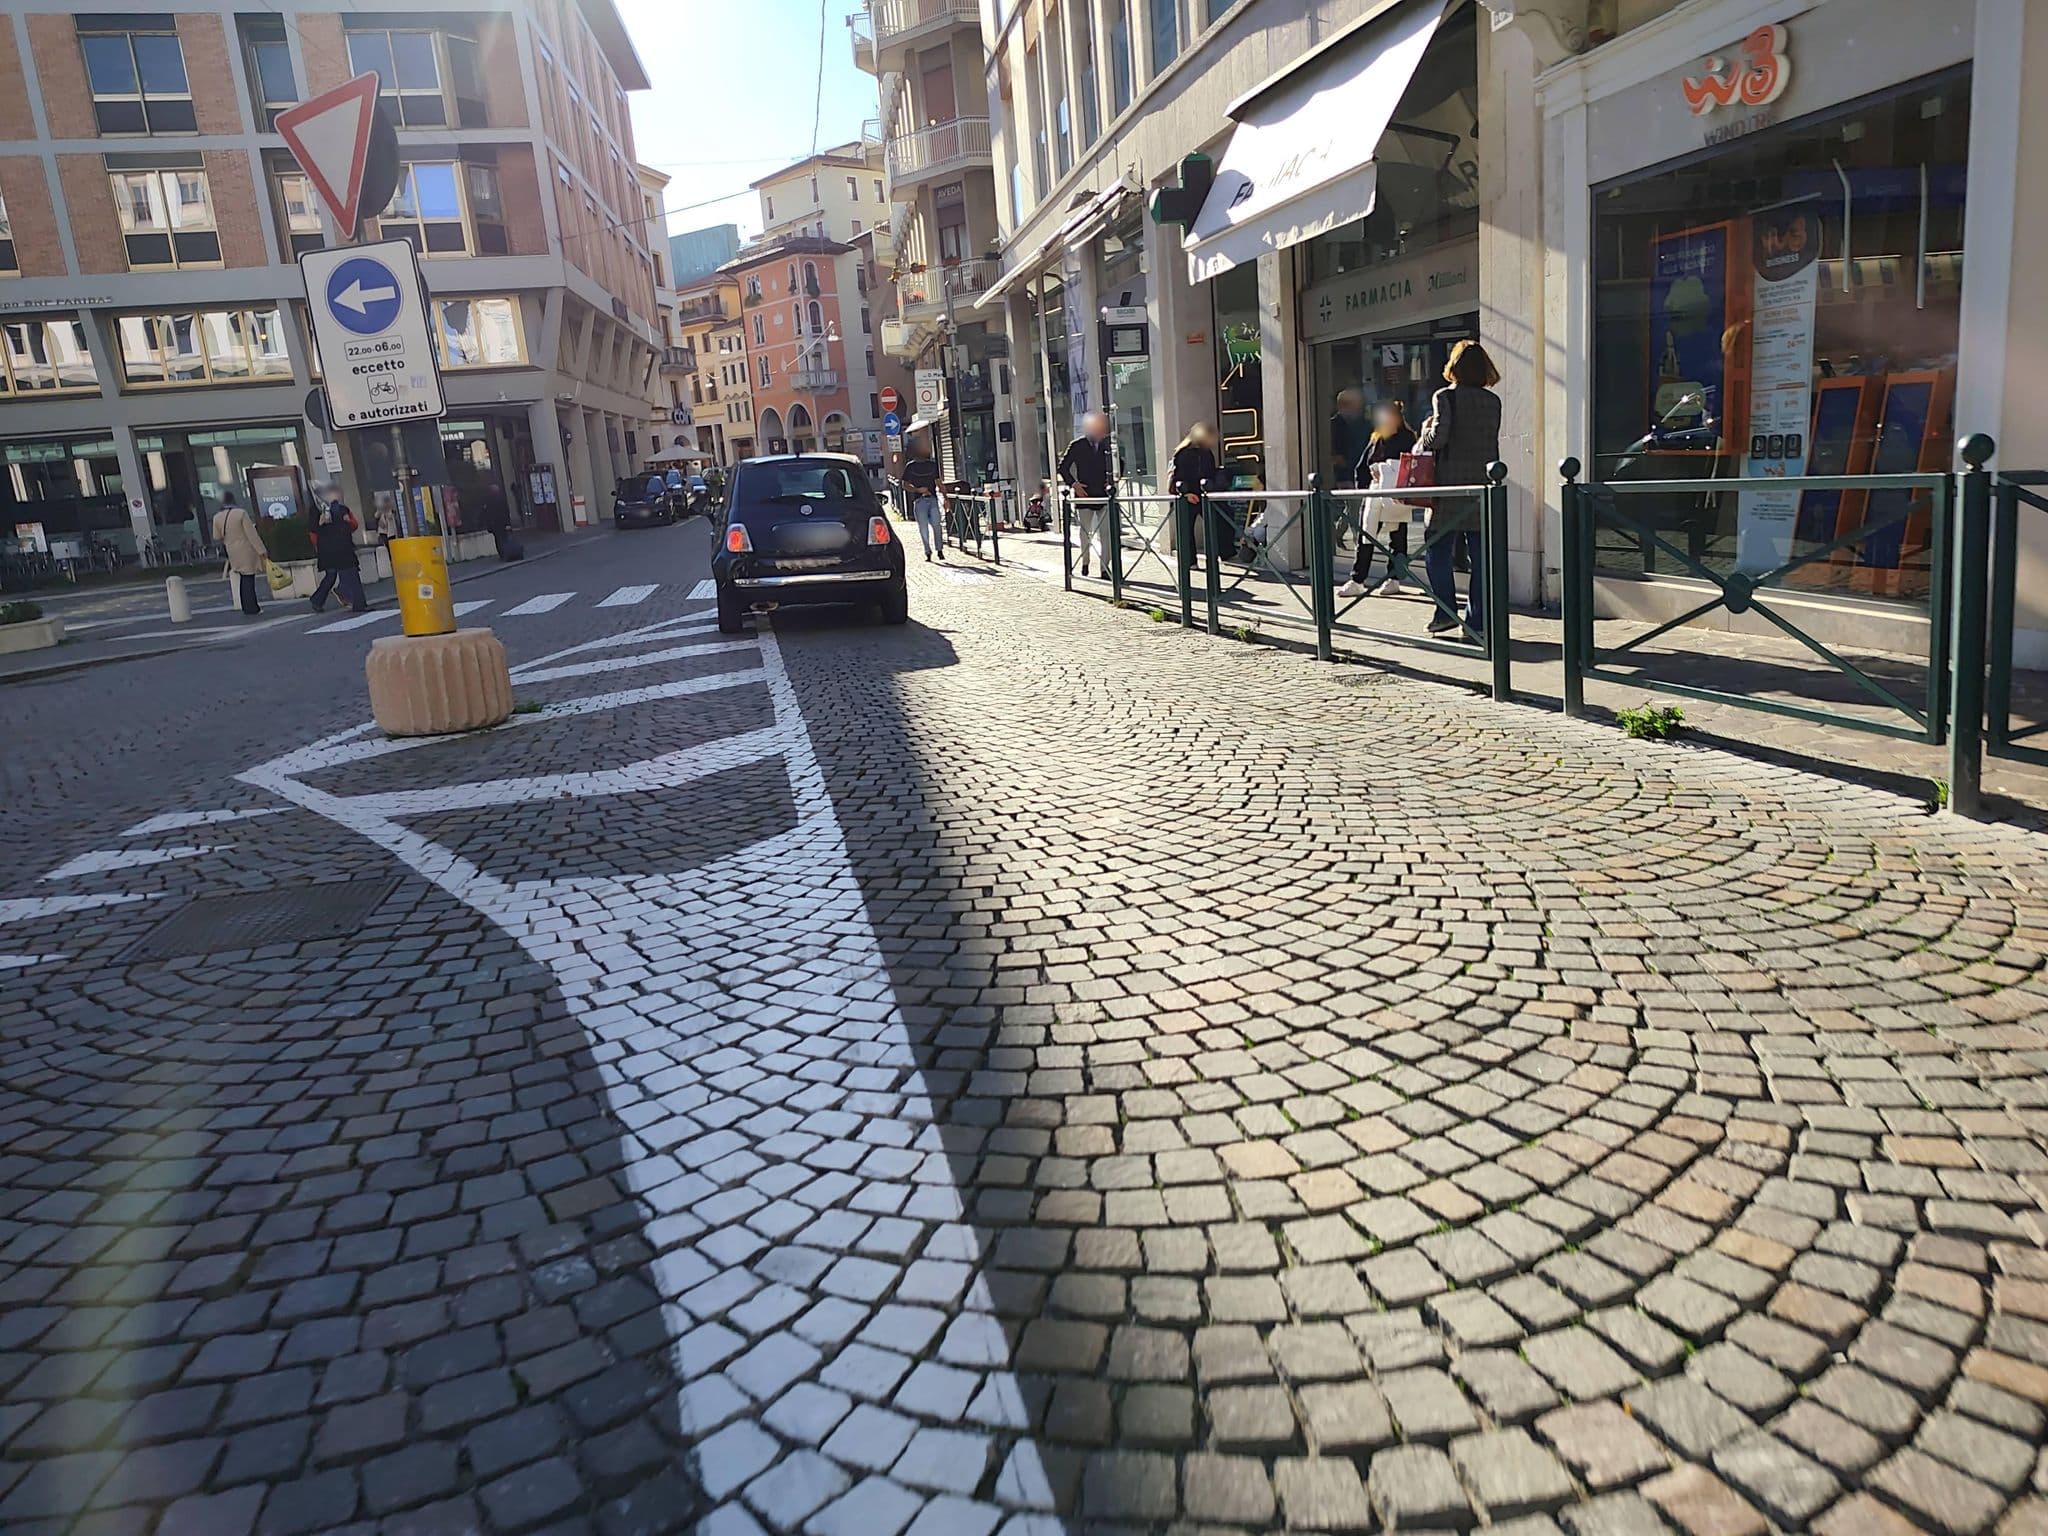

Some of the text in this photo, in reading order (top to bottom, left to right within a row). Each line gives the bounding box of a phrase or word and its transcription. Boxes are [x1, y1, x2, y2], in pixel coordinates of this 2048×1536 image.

[1345, 279, 1413, 311] FARMACIA
[351, 359, 406, 376] eccetto
[347, 400, 429, 422] e autorizzati
